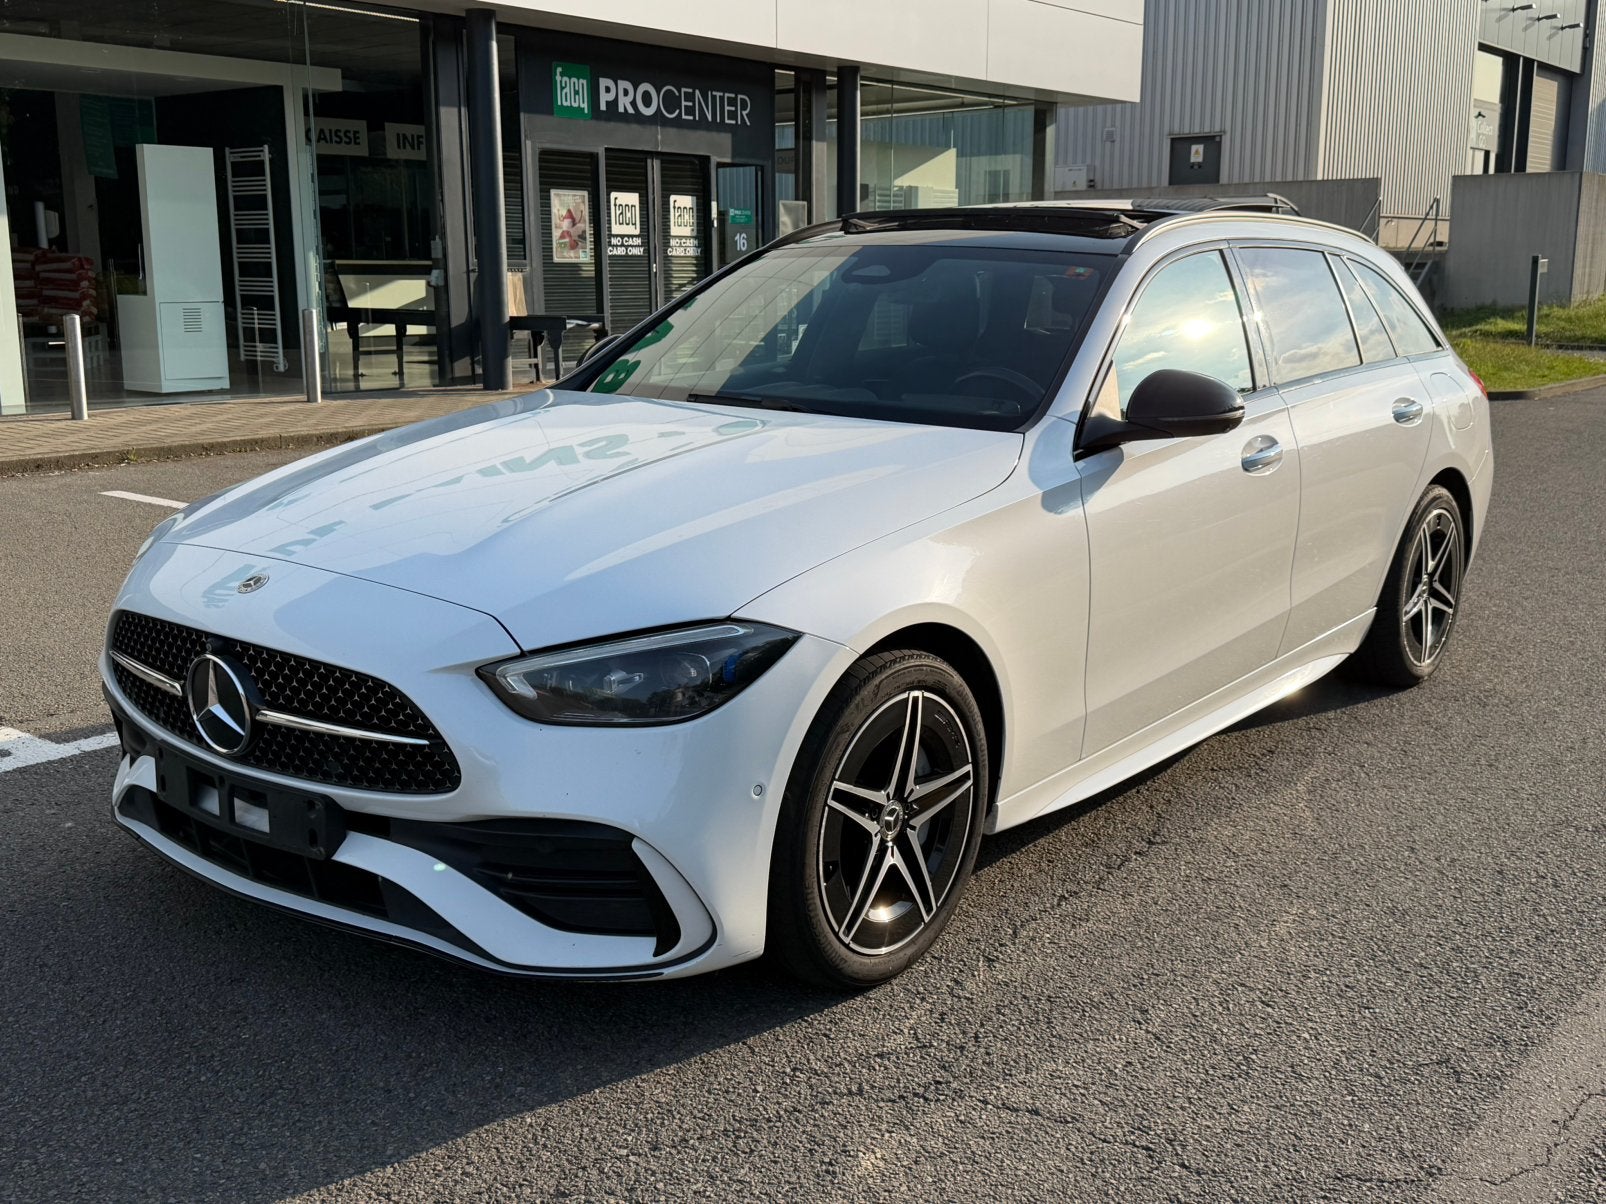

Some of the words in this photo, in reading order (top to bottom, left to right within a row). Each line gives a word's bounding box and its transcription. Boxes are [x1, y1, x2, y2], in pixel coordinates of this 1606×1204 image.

[555, 66, 588, 114] facq
[598, 77, 751, 126] PROCENTER
[613, 196, 637, 231] facq
[672, 199, 695, 232] facq
[611, 237, 622, 246] NO
[623, 237, 642, 246] CASH
[669, 238, 680, 247] NO
[734, 232, 748, 251] 16
[607, 246, 626, 255] CARD
[627, 247, 645, 255] ONLY
[667, 247, 684, 256] CARD
